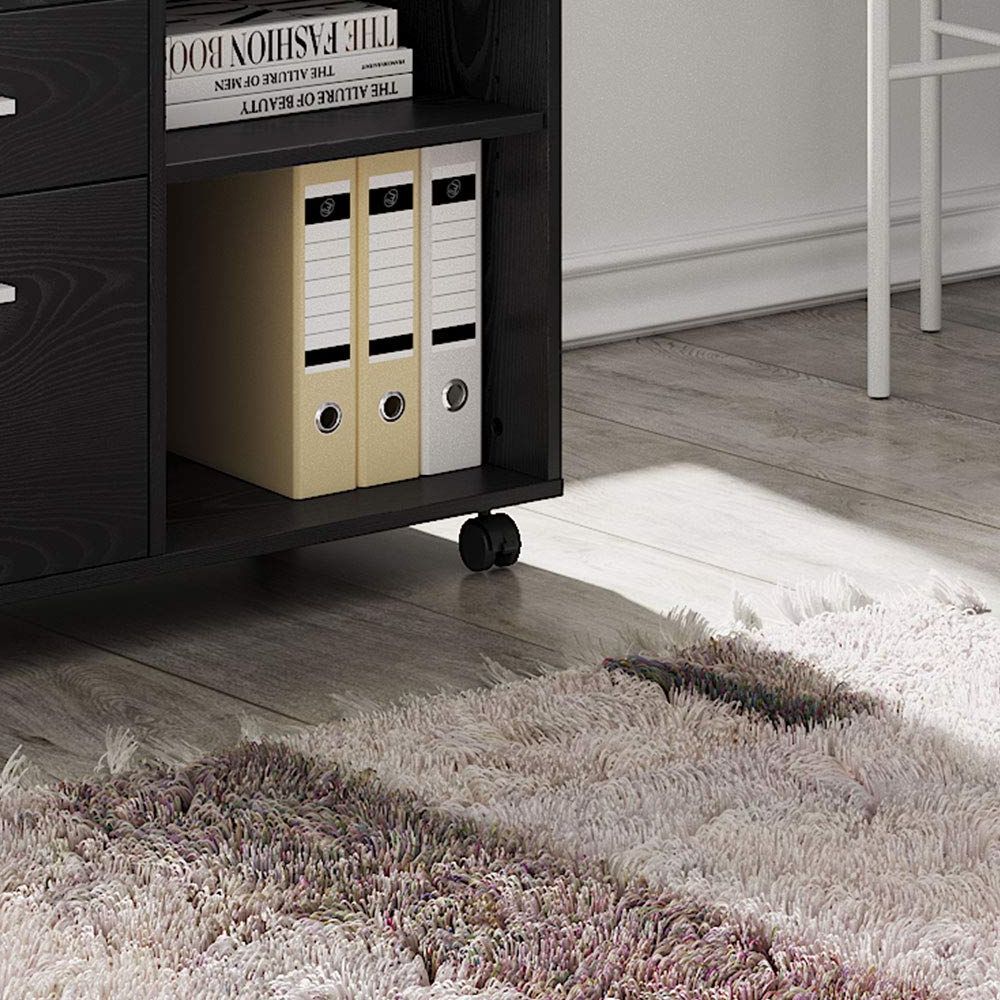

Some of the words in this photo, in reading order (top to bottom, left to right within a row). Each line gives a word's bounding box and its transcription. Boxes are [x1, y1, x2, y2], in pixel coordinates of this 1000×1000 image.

[343, 15, 395, 52] THE
[230, 21, 338, 67] FASHION
[243, 75, 260, 88] OF
[262, 67, 309, 86] ALLURE
[310, 65, 335, 80] THE
[214, 77, 242, 92] MEN
[371, 81, 399, 98] THE
[296, 92, 316, 108] OF
[317, 85, 369, 105] ALLURE
[240, 94, 294, 115] BEAUTY
